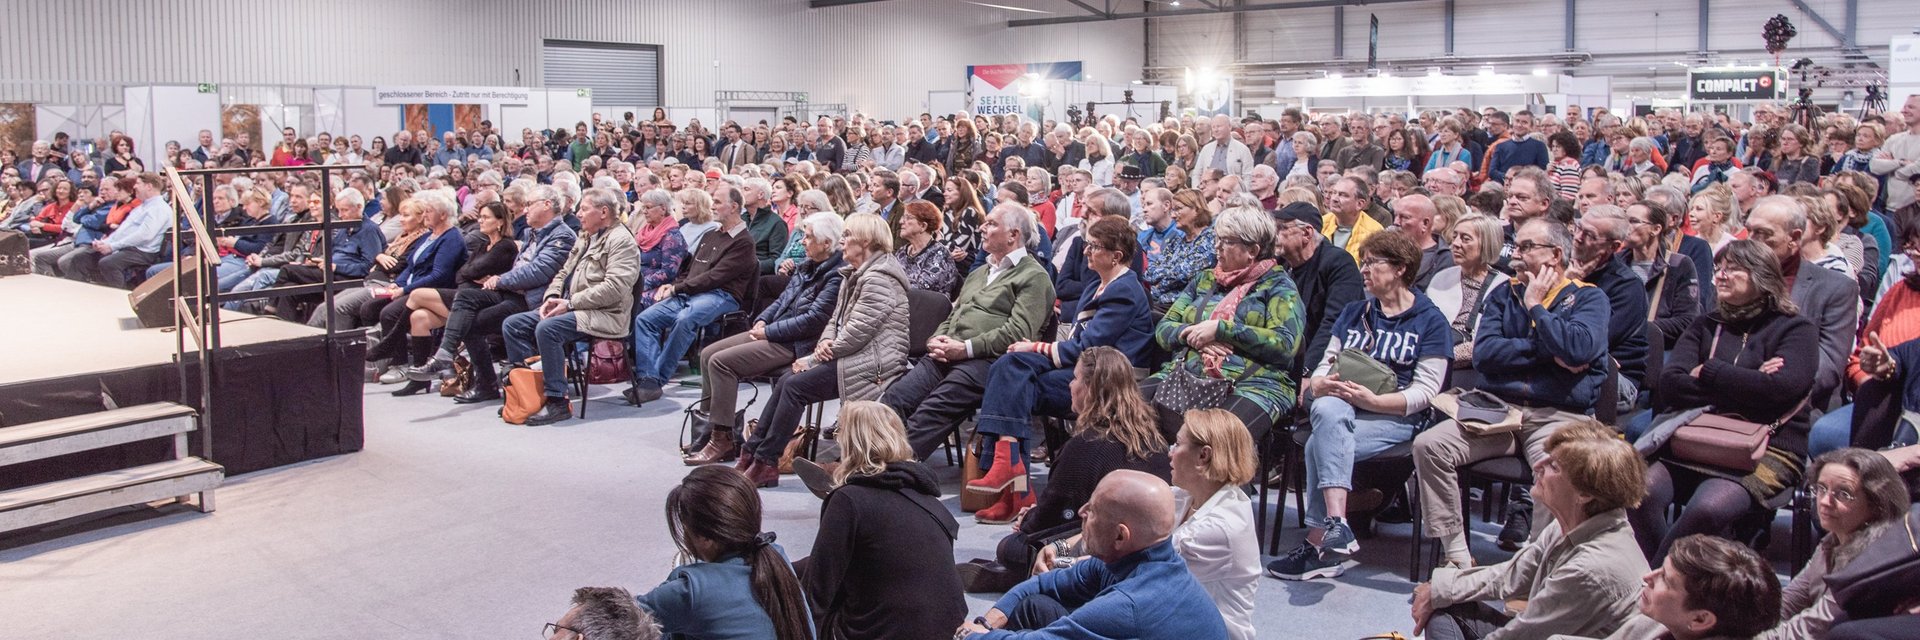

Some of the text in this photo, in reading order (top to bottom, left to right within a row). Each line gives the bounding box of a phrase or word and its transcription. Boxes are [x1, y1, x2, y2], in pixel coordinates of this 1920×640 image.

[1697, 79, 1758, 92] COMPACT
[378, 91, 423, 99] geschlossener
[492, 92, 528, 100] Berechtigung
[977, 105, 1023, 114] WECHSEL
